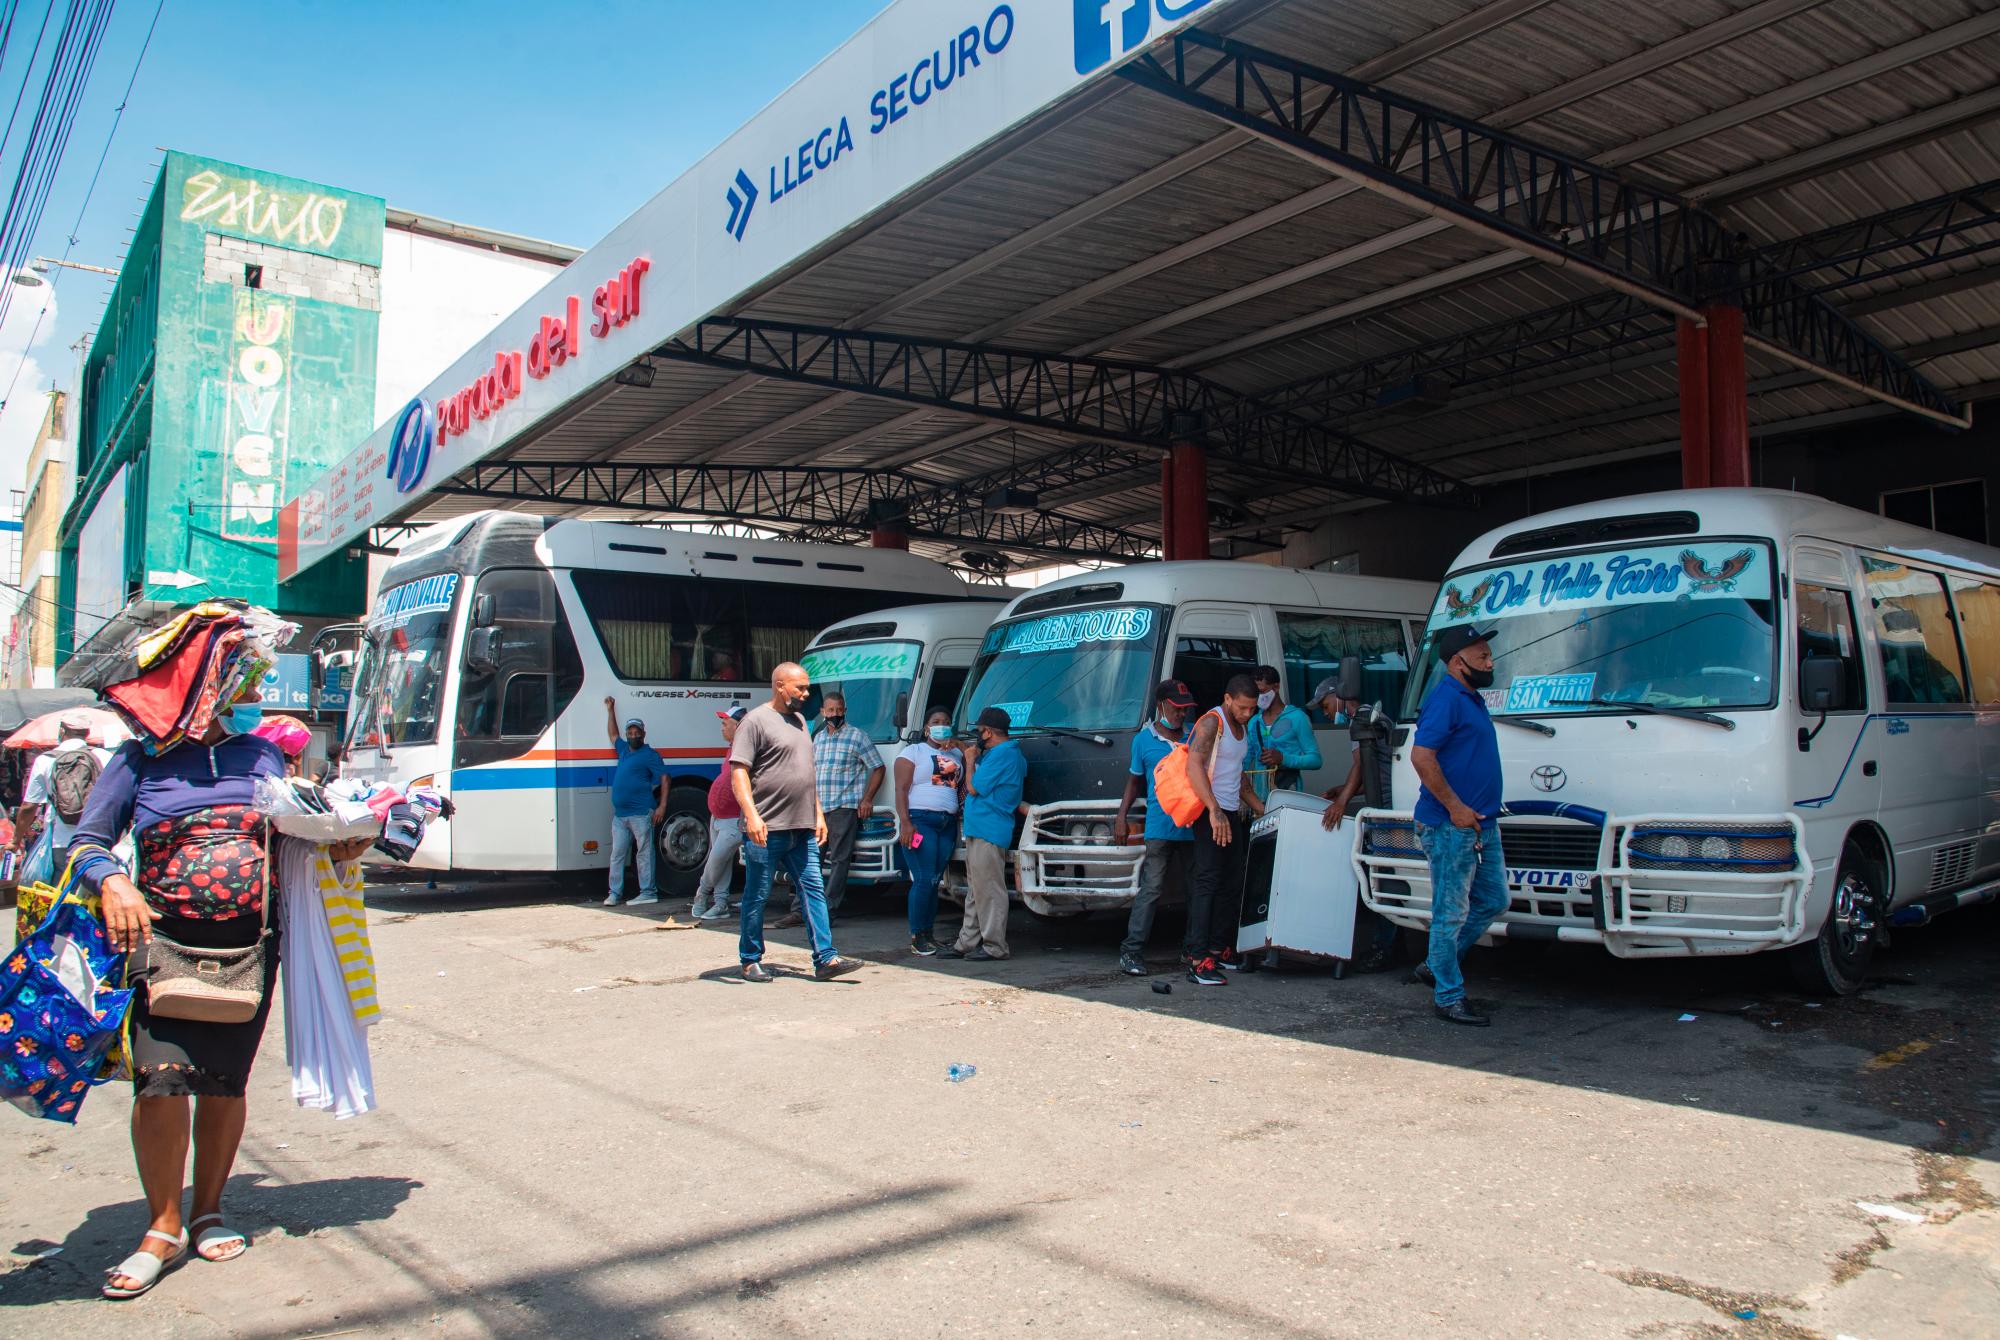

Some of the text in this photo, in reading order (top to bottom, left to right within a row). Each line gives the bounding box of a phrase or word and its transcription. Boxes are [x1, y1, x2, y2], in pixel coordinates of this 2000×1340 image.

[769, 3, 1015, 204] LLEGA SEGURO
[527, 295, 580, 380] del
[590, 256, 651, 338] sur
[1485, 554, 1682, 614] Del Valle Tours
[1074, 608, 1152, 641] TOURS
[1510, 687, 1543, 709] SAN
[1544, 685, 1588, 706] JUAN
[1515, 677, 1591, 687] EXPRESO
[1507, 871, 1573, 887] YOTA
